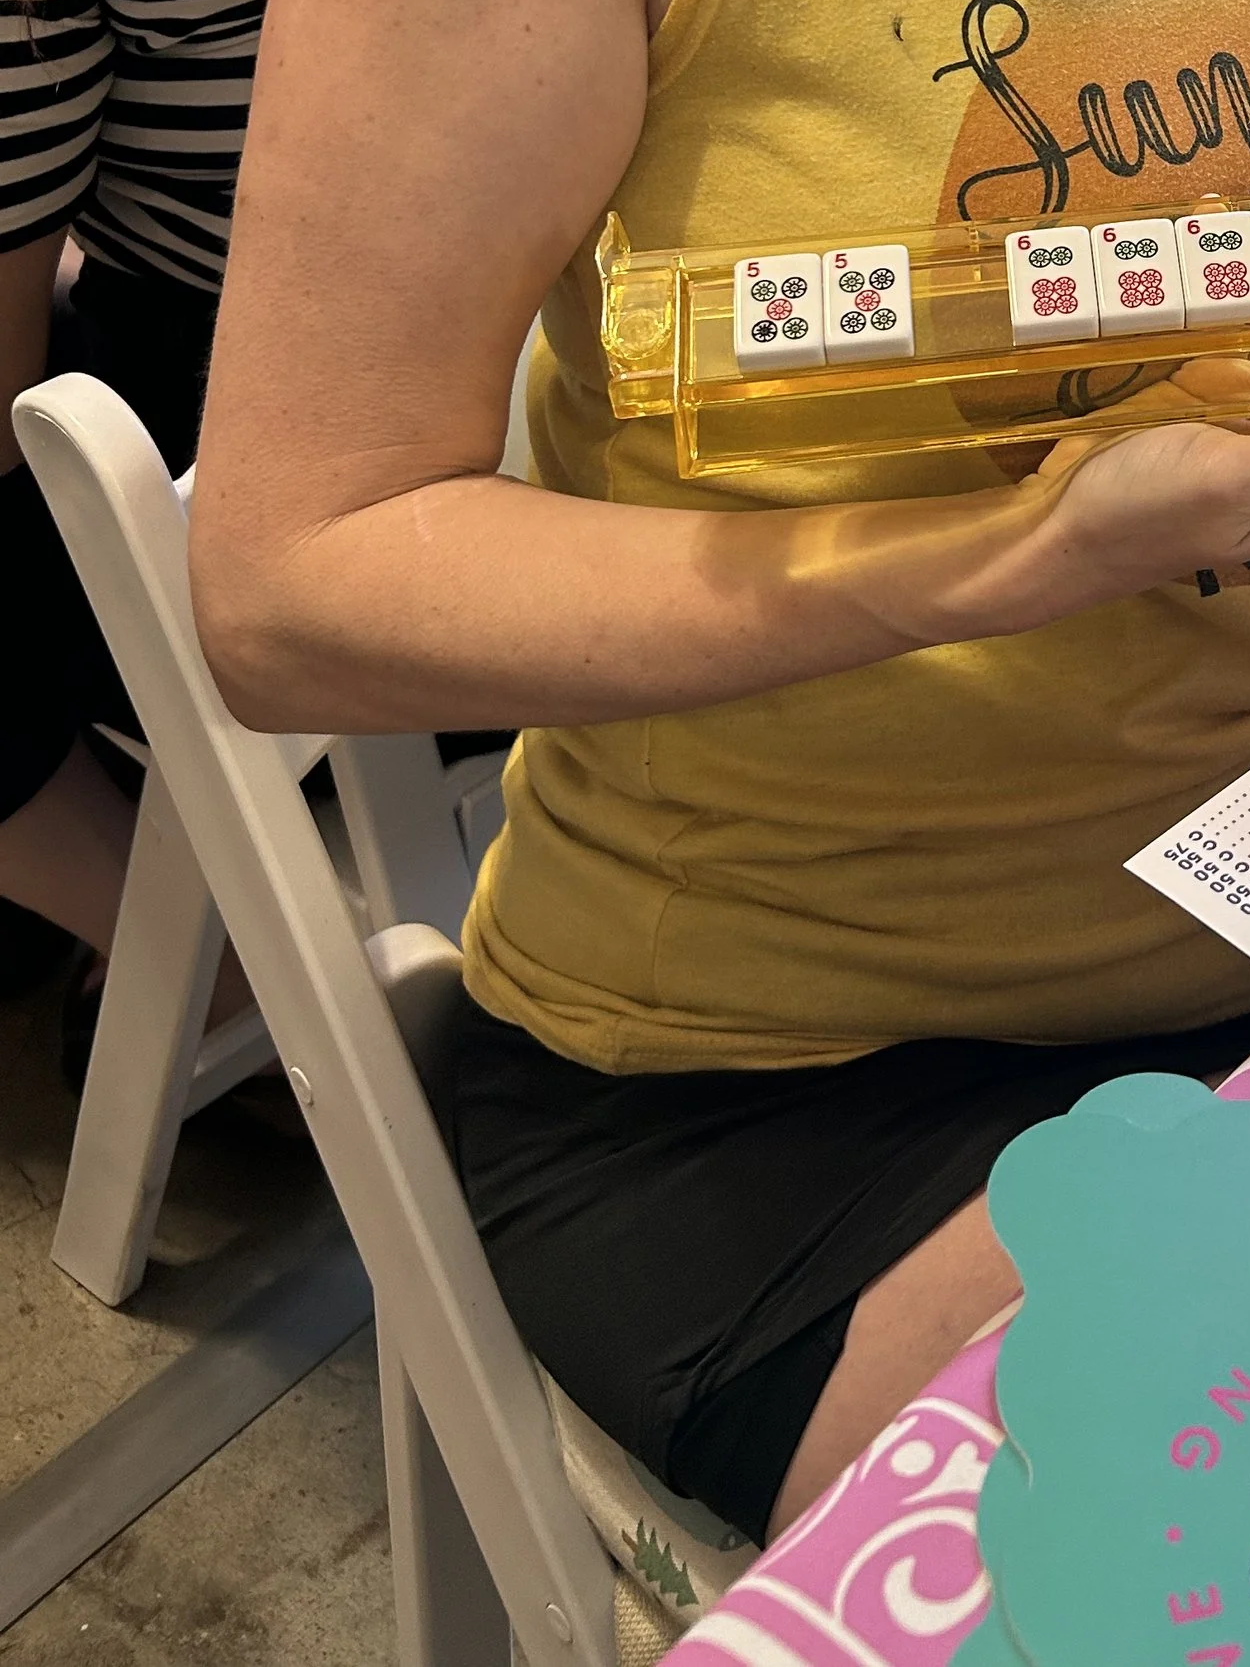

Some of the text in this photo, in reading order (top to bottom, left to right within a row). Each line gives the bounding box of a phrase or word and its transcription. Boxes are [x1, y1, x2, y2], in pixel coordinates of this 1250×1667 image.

[1103, 227, 1117, 243] 6
[1187, 219, 1200, 235] 6
[1017, 235, 1031, 251] 6
[834, 252, 848, 270] 5
[746, 261, 760, 279] 5
[1187, 830, 1203, 841] C
[1163, 841, 1189, 861] 75
[1234, 861, 1250, 873] C
[1209, 873, 1235, 893] 50
